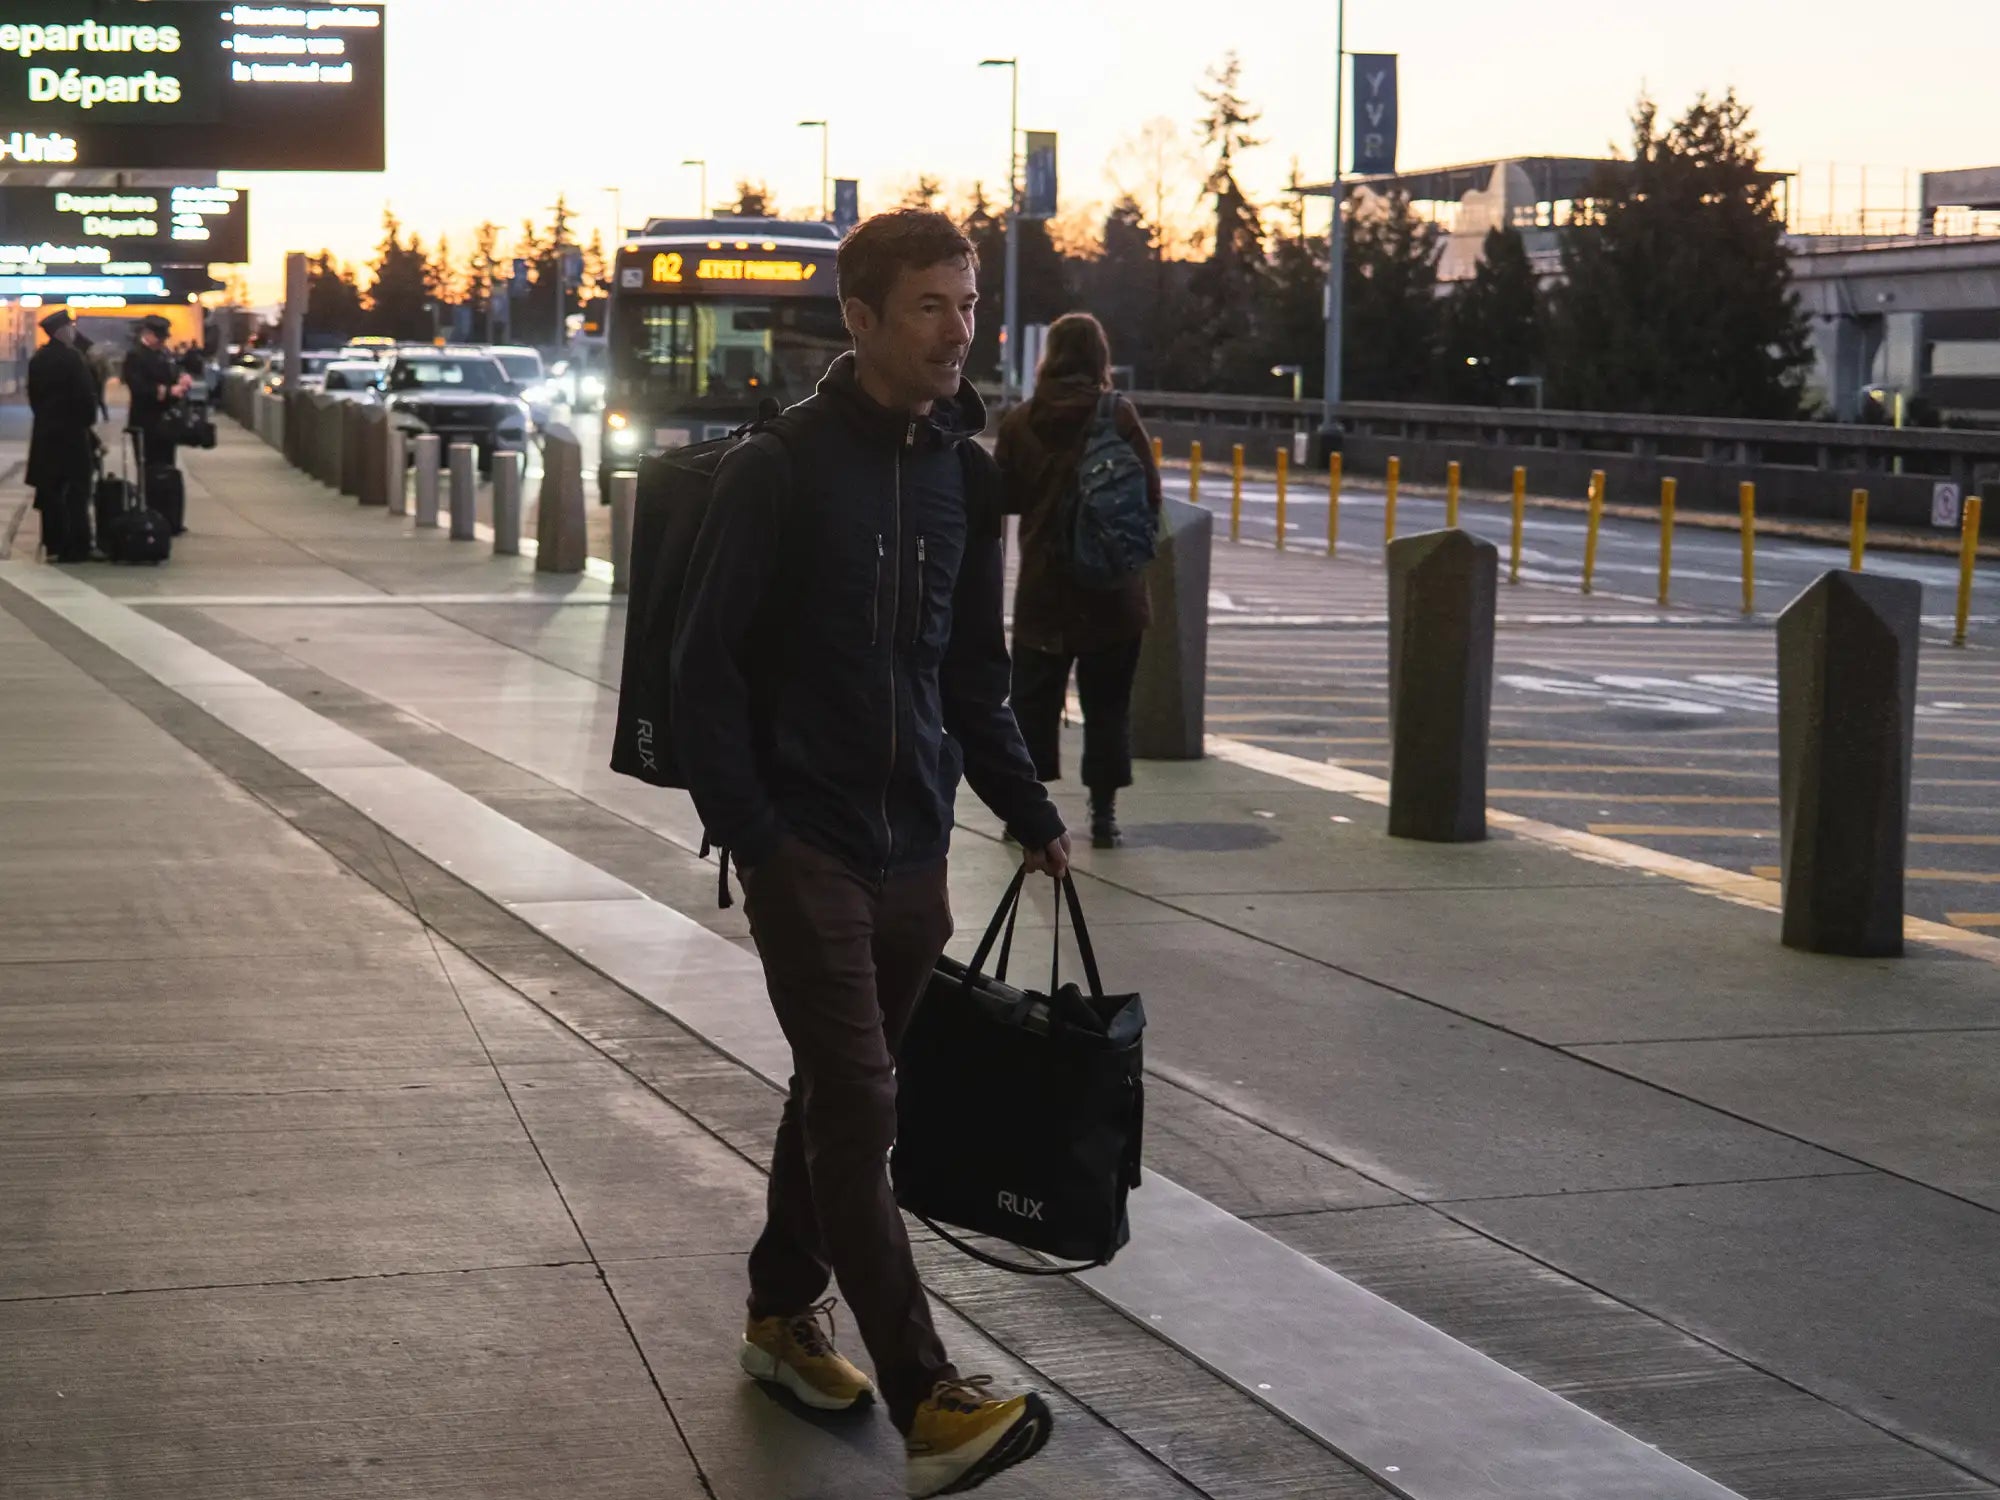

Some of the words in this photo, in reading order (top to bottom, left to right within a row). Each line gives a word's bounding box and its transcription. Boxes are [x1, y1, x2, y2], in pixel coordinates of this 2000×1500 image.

[28, 67, 181, 108] Départs
[1364, 71, 1385, 157] YVR
[637, 718, 658, 772] RUX
[998, 1190, 1043, 1221] RUX
